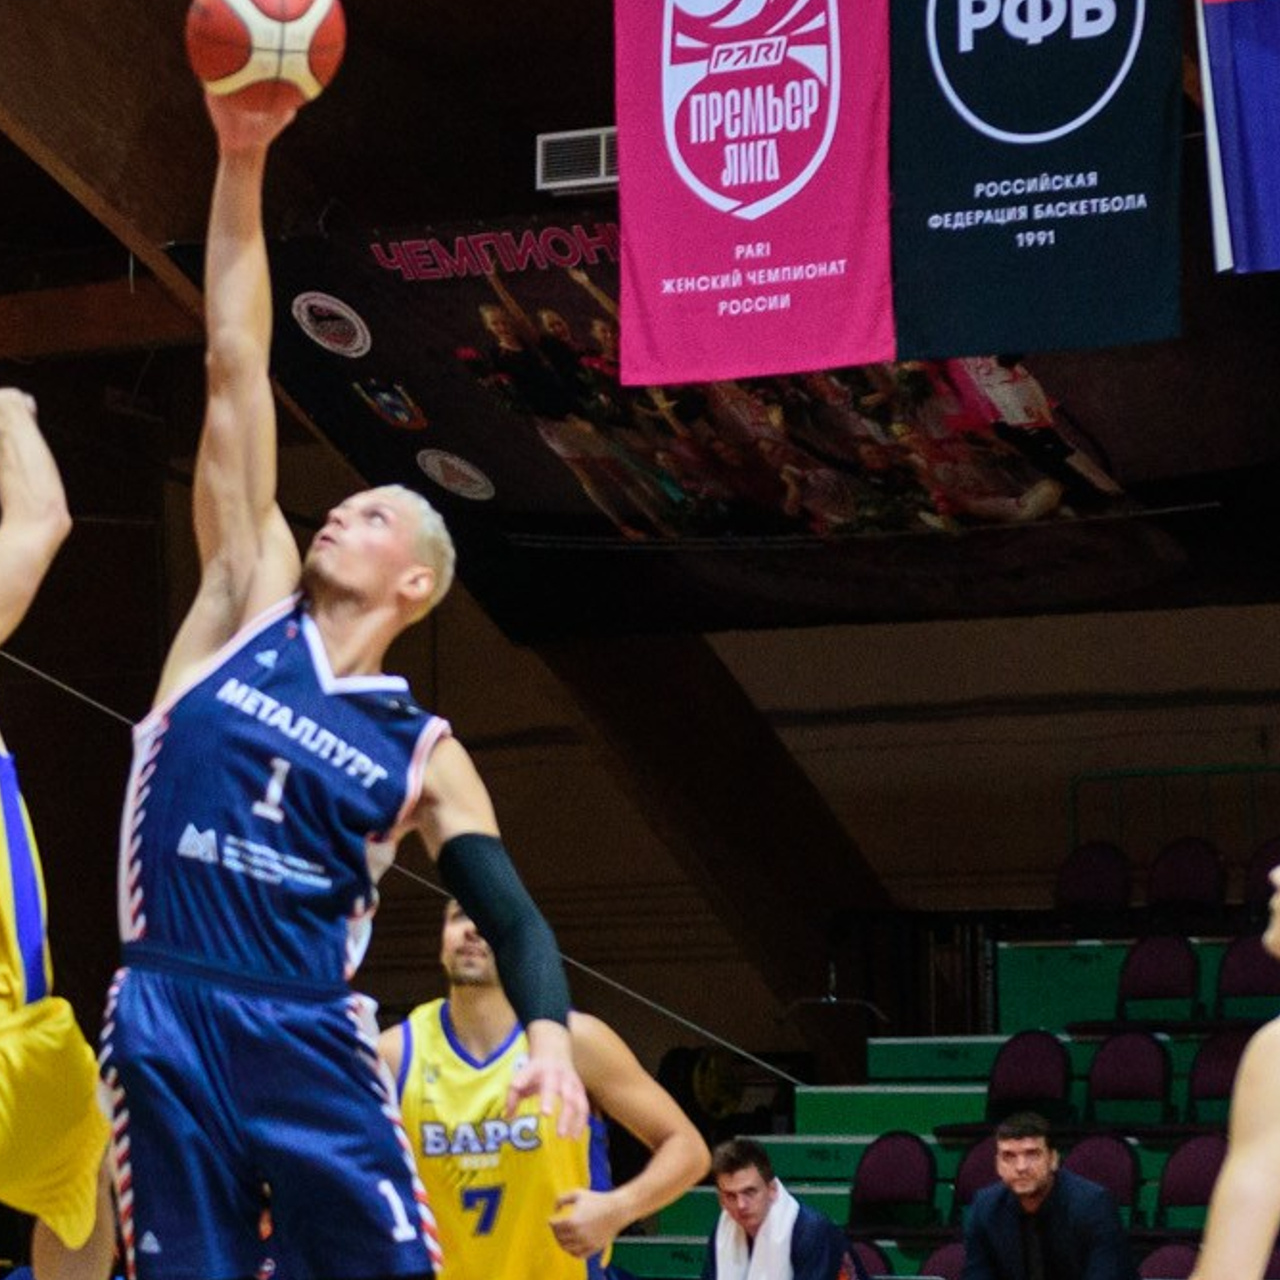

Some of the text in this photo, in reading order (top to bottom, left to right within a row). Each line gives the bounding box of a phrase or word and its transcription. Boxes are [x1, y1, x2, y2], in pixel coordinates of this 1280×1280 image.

[711, 38, 785, 70] PARI
[690, 78, 819, 143] ПРЕМЬЕР
[722, 139, 780, 187] ЛИГА
[973, 171, 1099, 199] РОССИЙСКАЯ
[927, 193, 1149, 231] ФЕДЕРАЦИЯ БАСКЕТБОЛА
[734, 242, 771, 260] PARI
[1016, 230, 1056, 248] 1991
[661, 259, 848, 294] ЖЕНСКИЙ ЧЕМПИОНАТ
[717, 293, 791, 317] РОССИИ
[216, 678, 388, 789] МЕТАЛЛУРГ
[252, 757, 291, 824] 1
[422, 1115, 542, 1157] БАРС
[378, 1179, 417, 1242] 1
[461, 1185, 505, 1237] 7
